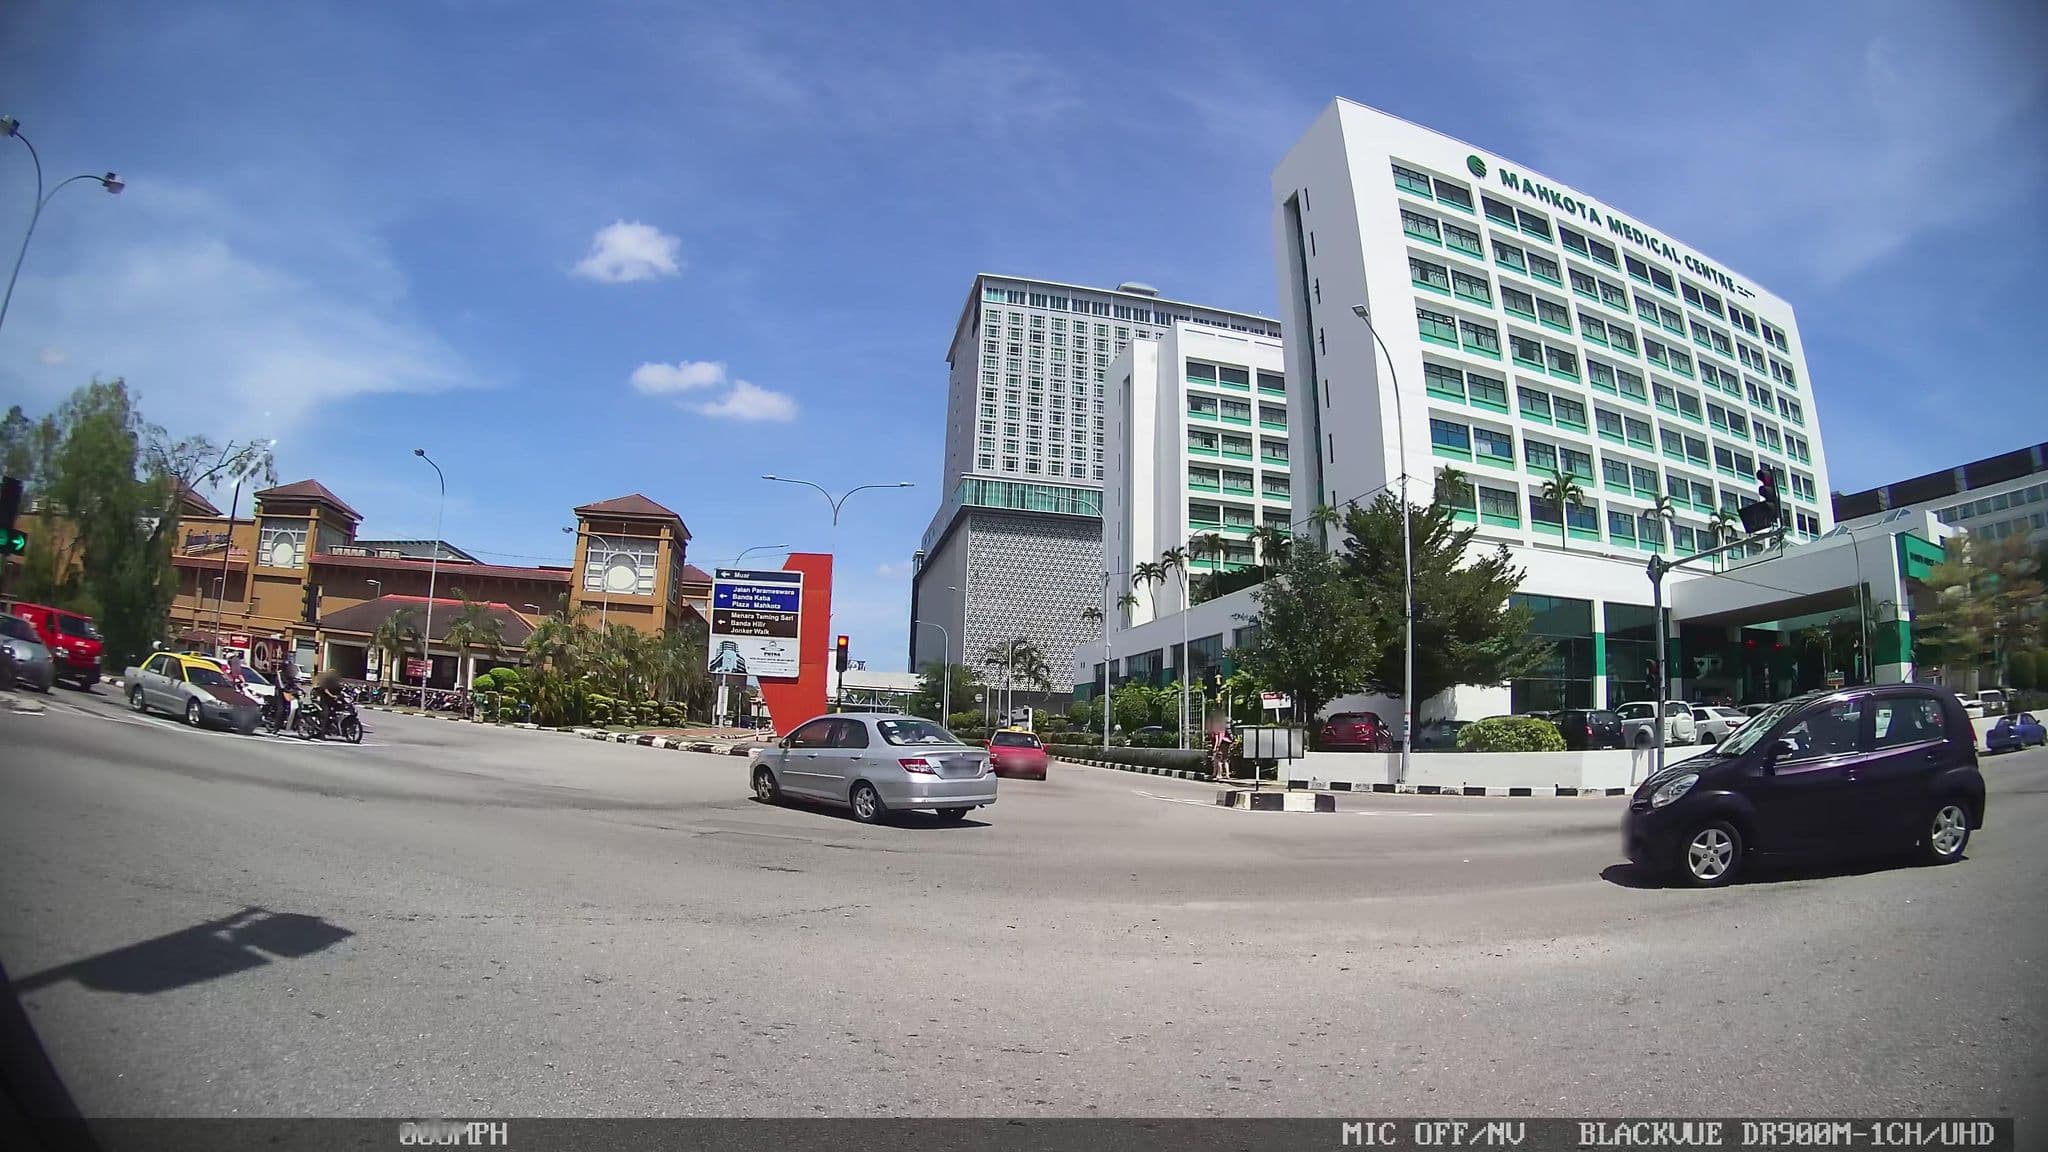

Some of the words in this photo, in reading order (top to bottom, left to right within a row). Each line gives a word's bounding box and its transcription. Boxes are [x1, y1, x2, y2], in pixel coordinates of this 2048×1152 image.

[1499, 168, 1602, 227] MAHKOTA
[1606, 215, 1682, 265] MEDICAL
[1684, 255, 1736, 293] CENTRE
[734, 571, 750, 579] Muar
[752, 587, 795, 595] Parameswara
[754, 594, 771, 602] Kaba
[731, 611, 754, 619] Menara
[756, 613, 779, 621] Taming
